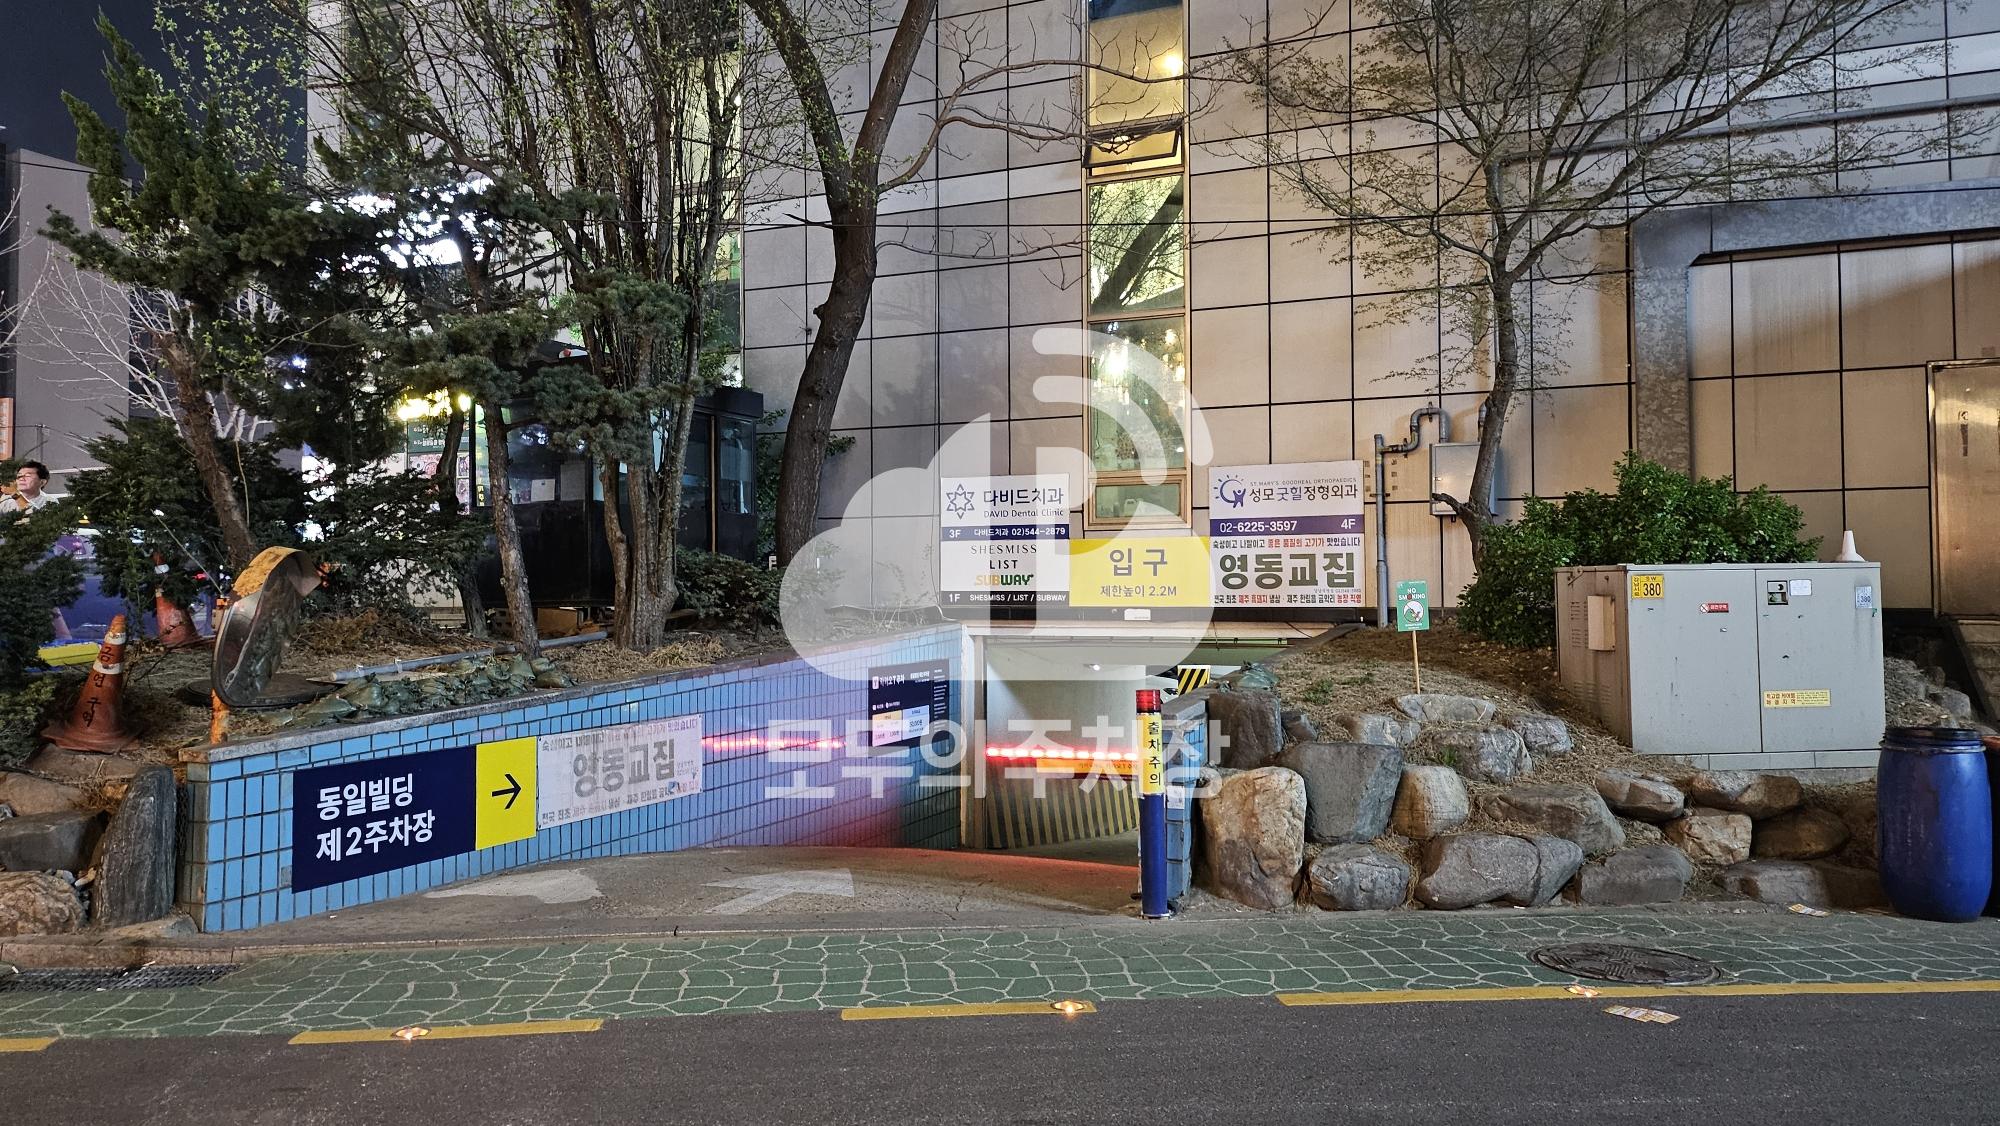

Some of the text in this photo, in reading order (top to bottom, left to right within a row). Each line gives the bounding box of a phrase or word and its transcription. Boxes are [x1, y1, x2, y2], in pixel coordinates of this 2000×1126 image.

[983, 488, 1064, 506] 다비드치과
[1249, 484, 1358, 503] 성모굿힐정형외과
[984, 508, 1064, 518] DAVID Dental Clinic
[949, 527, 1066, 538] 3F 다비드치과 02)544-2879
[1220, 519, 1356, 533] 02-6225-3597 4F
[1305, 538, 1325, 547] 고기가
[1326, 537, 1361, 547] 맛있습니다
[971, 544, 1037, 554] SHESMISS
[989, 560, 1018, 569] LIST
[1219, 552, 1355, 590] 영동교집
[975, 574, 1034, 586] SUBWAY
[1100, 585, 1177, 598] 제한높이 2.2M
[1643, 582, 1661, 596] 380
[949, 593, 961, 602] 1F
[969, 594, 1005, 602] SHESMISS
[1013, 594, 1028, 602] LIST
[1036, 594, 1066, 602] SUBWAY
[1148, 721, 1161, 786] 출차주의
[316, 773, 414, 821] 동일빌딩
